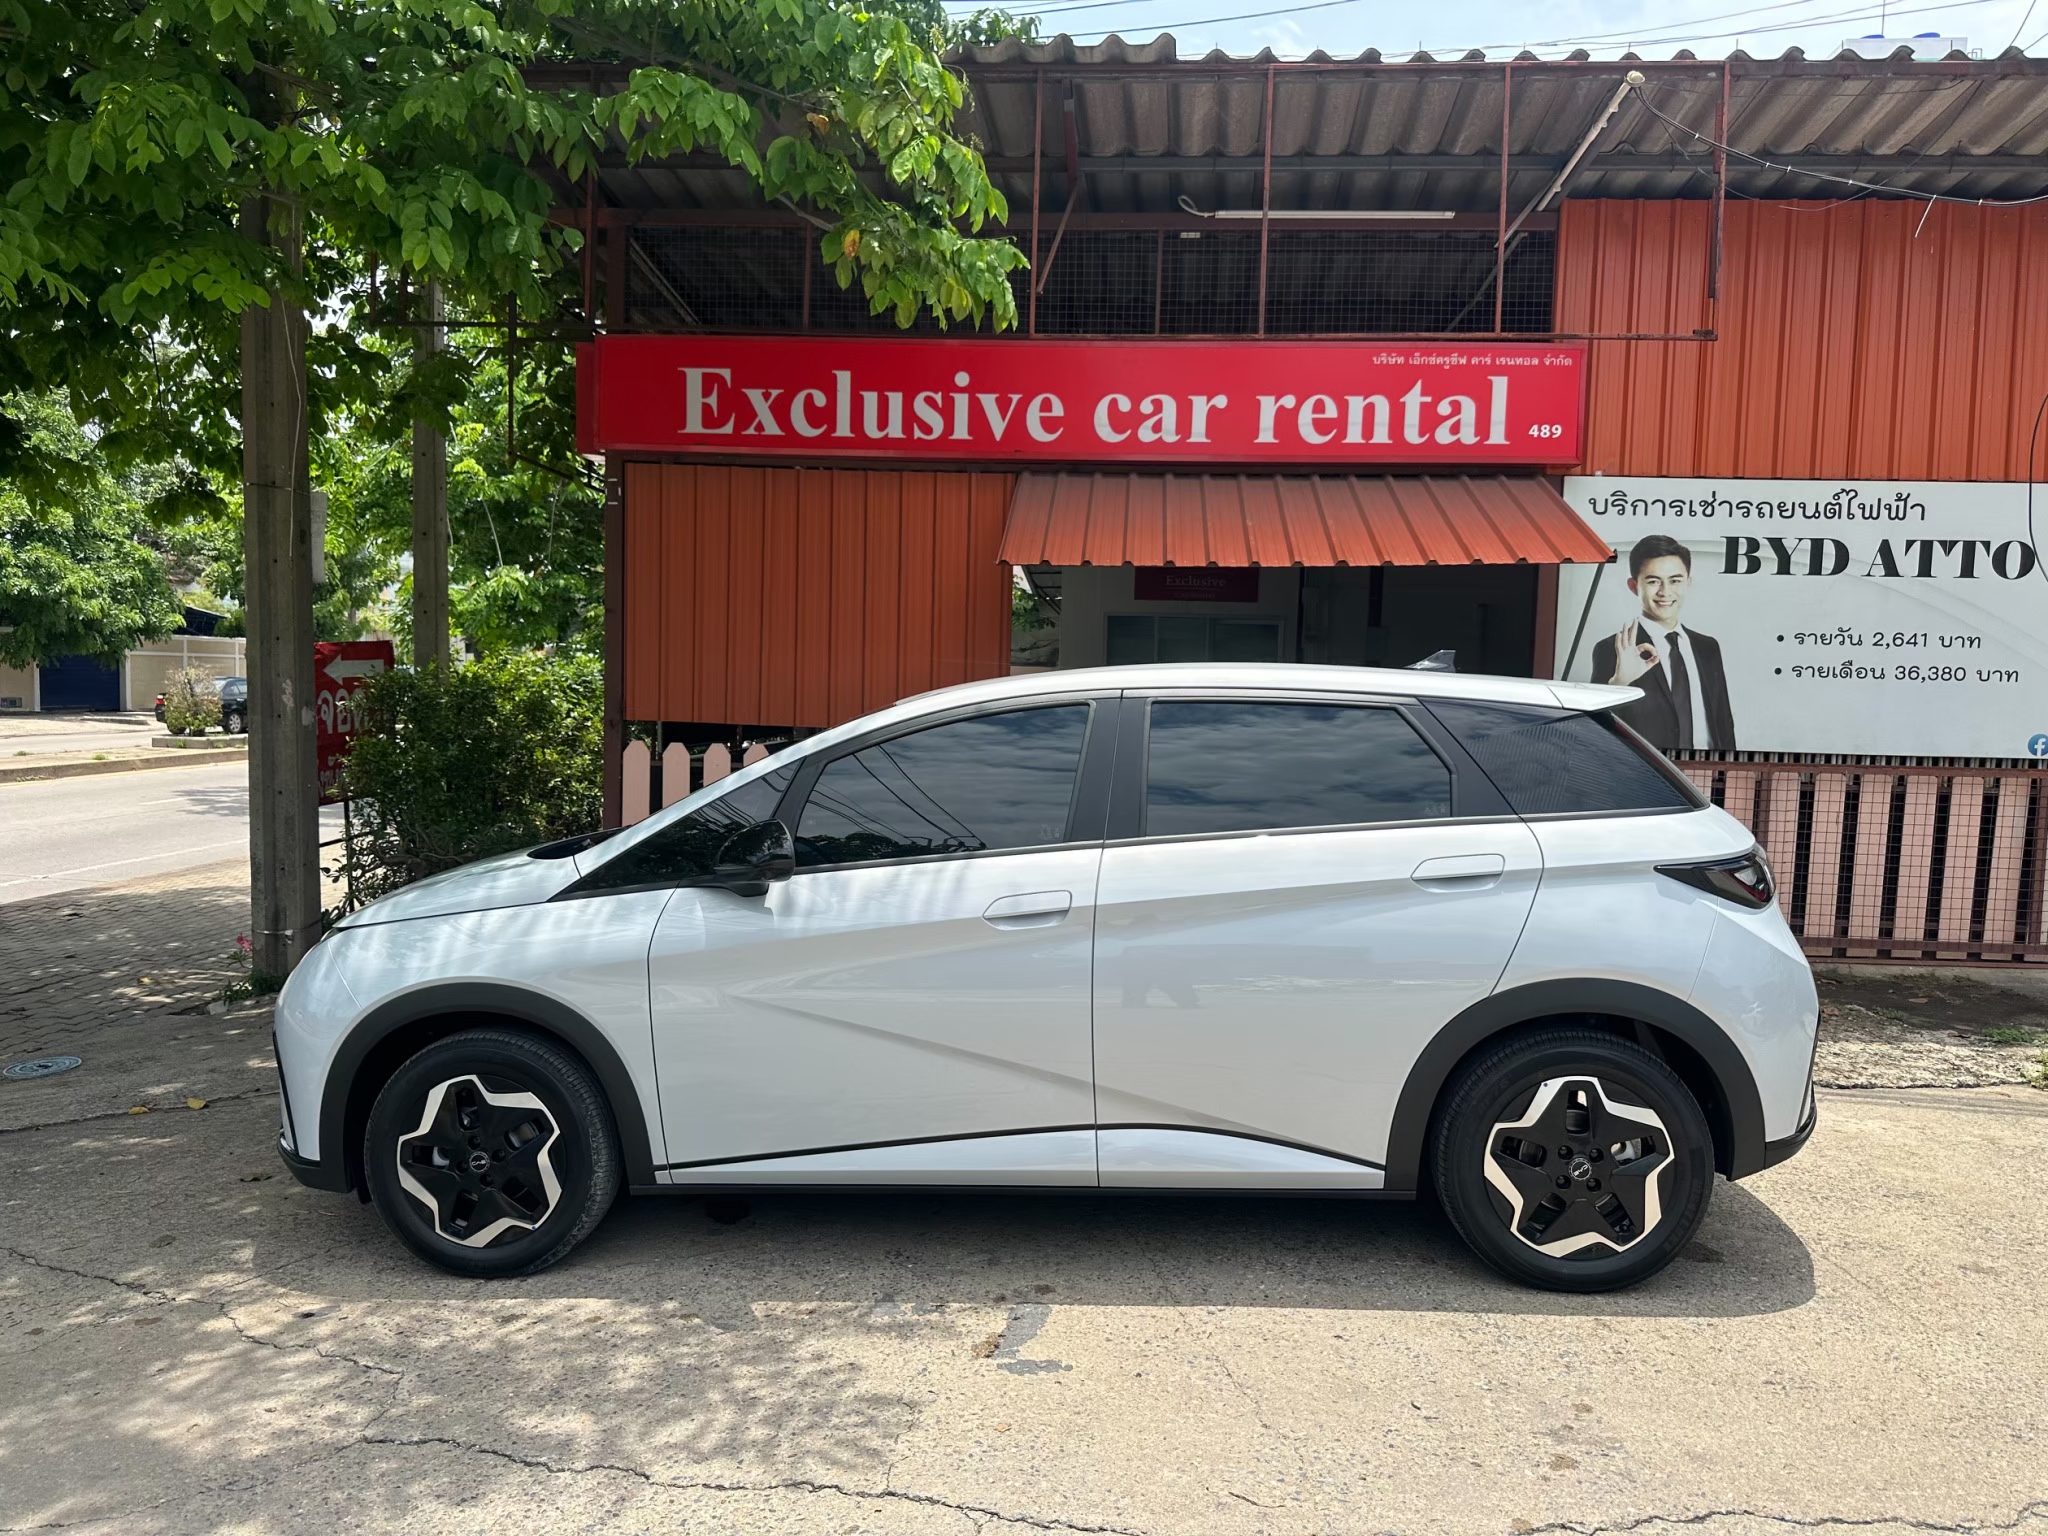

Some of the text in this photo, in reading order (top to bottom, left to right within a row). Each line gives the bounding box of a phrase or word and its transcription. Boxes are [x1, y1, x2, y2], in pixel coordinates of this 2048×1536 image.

[1372, 353, 1405, 365] บริษัท
[1471, 353, 1492, 366] คาร์
[1495, 356, 1540, 366] เรนทอล
[1543, 353, 1573, 366] จำกัด
[677, 367, 1511, 445] Exclusive car rental
[1528, 424, 1562, 438] 489
[1588, 488, 1926, 521] บริการเช่ารถยนต์ไฟฟ้า
[1718, 535, 2036, 580] BYD ATTO
[1794, 627, 1981, 649] รายวัน 2,641 บาท
[1791, 660, 2019, 683] รายเดือน 36,380 บาท
